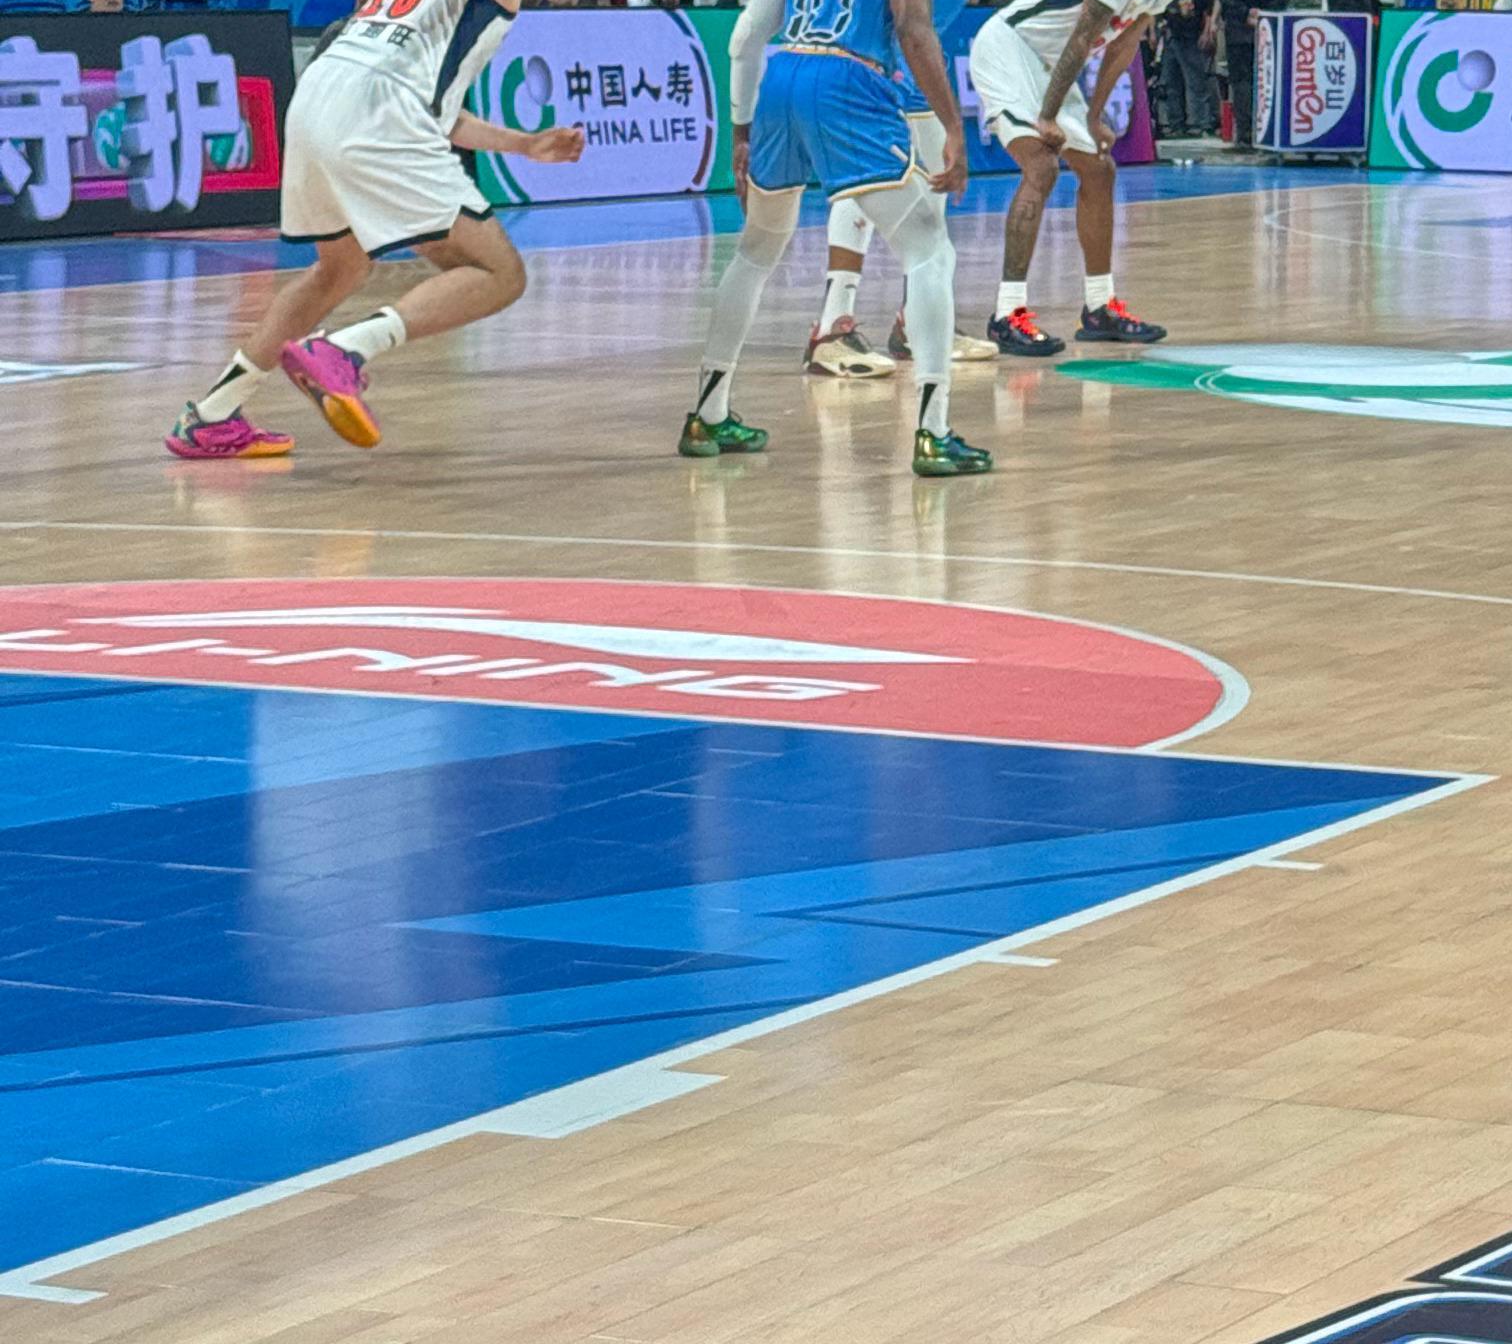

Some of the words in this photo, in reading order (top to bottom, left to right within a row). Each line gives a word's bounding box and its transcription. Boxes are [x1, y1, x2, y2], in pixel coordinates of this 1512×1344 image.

[565, 61, 694, 112] 中国人寿
[1325, 41, 1346, 110] 百岁山
[0, 33, 243, 221] 守护
[651, 116, 698, 143] LIFE
